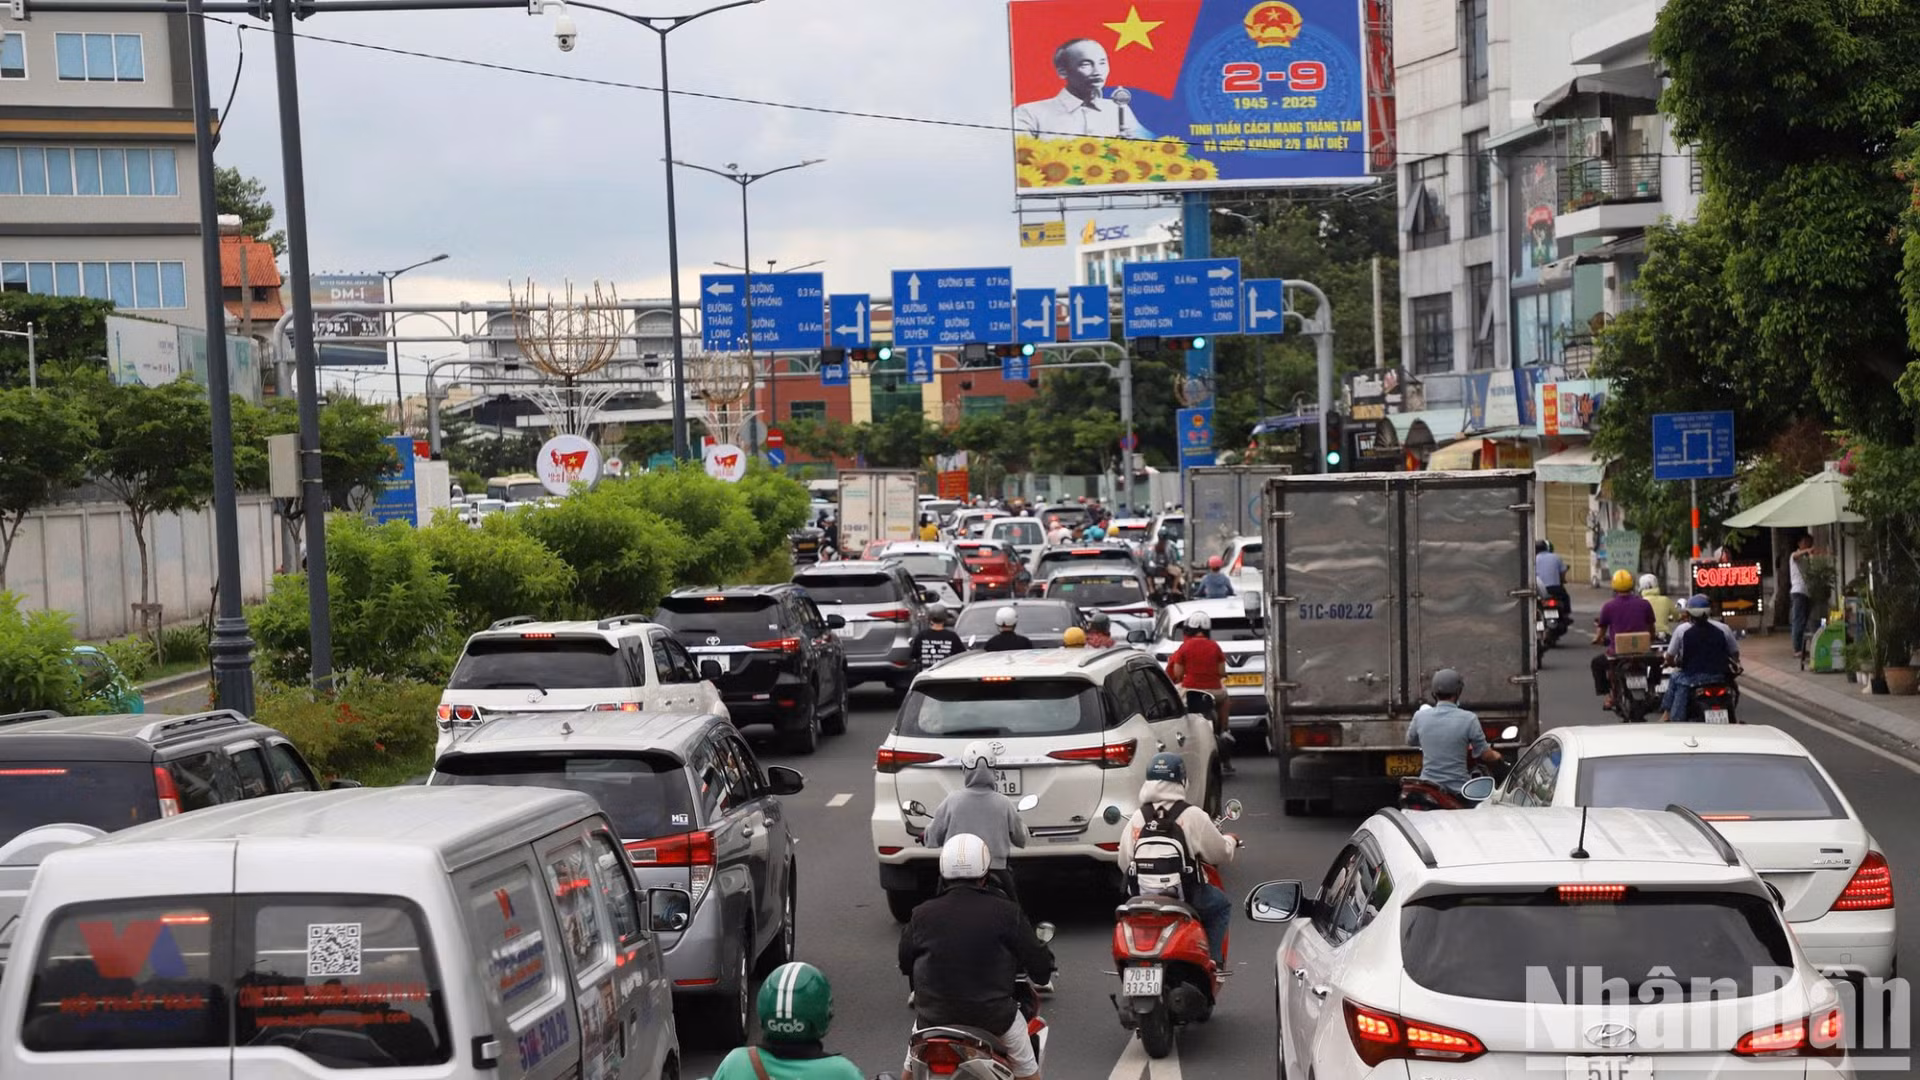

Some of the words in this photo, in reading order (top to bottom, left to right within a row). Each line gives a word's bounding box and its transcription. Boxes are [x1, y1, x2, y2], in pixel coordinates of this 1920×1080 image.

[1222, 60, 1327, 93] 2-9
[1233, 97, 1268, 109] 1945
[1282, 96, 1317, 108] 2025
[1190, 123, 1213, 136] TINH
[1244, 119, 1271, 134] CÁCH
[1273, 121, 1303, 136] MẠNG
[1305, 118, 1338, 133] THÁNG
[1341, 118, 1362, 132] TÁM
[1219, 136, 1246, 151] QUỐC
[1248, 136, 1283, 151] KHÁNH
[1285, 138, 1300, 149] 2/9
[1305, 135, 1325, 150] BẤT
[1327, 135, 1349, 151] DIỆT
[1097, 225, 1130, 241] SCSC
[997, 277, 1010, 286] Km
[797, 288, 808, 297] 0.3
[809, 288, 822, 297] Km
[1143, 284, 1165, 295] GIANG
[758, 295, 783, 307] PHÓNG
[998, 300, 1010, 309] Km
[707, 301, 733, 313] ĐƯỜNG
[1191, 309, 1202, 318] Km
[1213, 311, 1233, 321] LONG
[896, 316, 916, 326] PHAN
[998, 321, 1011, 331] Km
[809, 323, 822, 332] Km
[710, 329, 731, 339] LONG
[742, 332, 762, 342] CNG
[764, 331, 779, 341] HÒA
[1696, 566, 1760, 587] COFFEE
[1299, 604, 1374, 620] 51C-602.22
[1130, 969, 1156, 981] 70-B1
[768, 1019, 805, 1033] Grab
